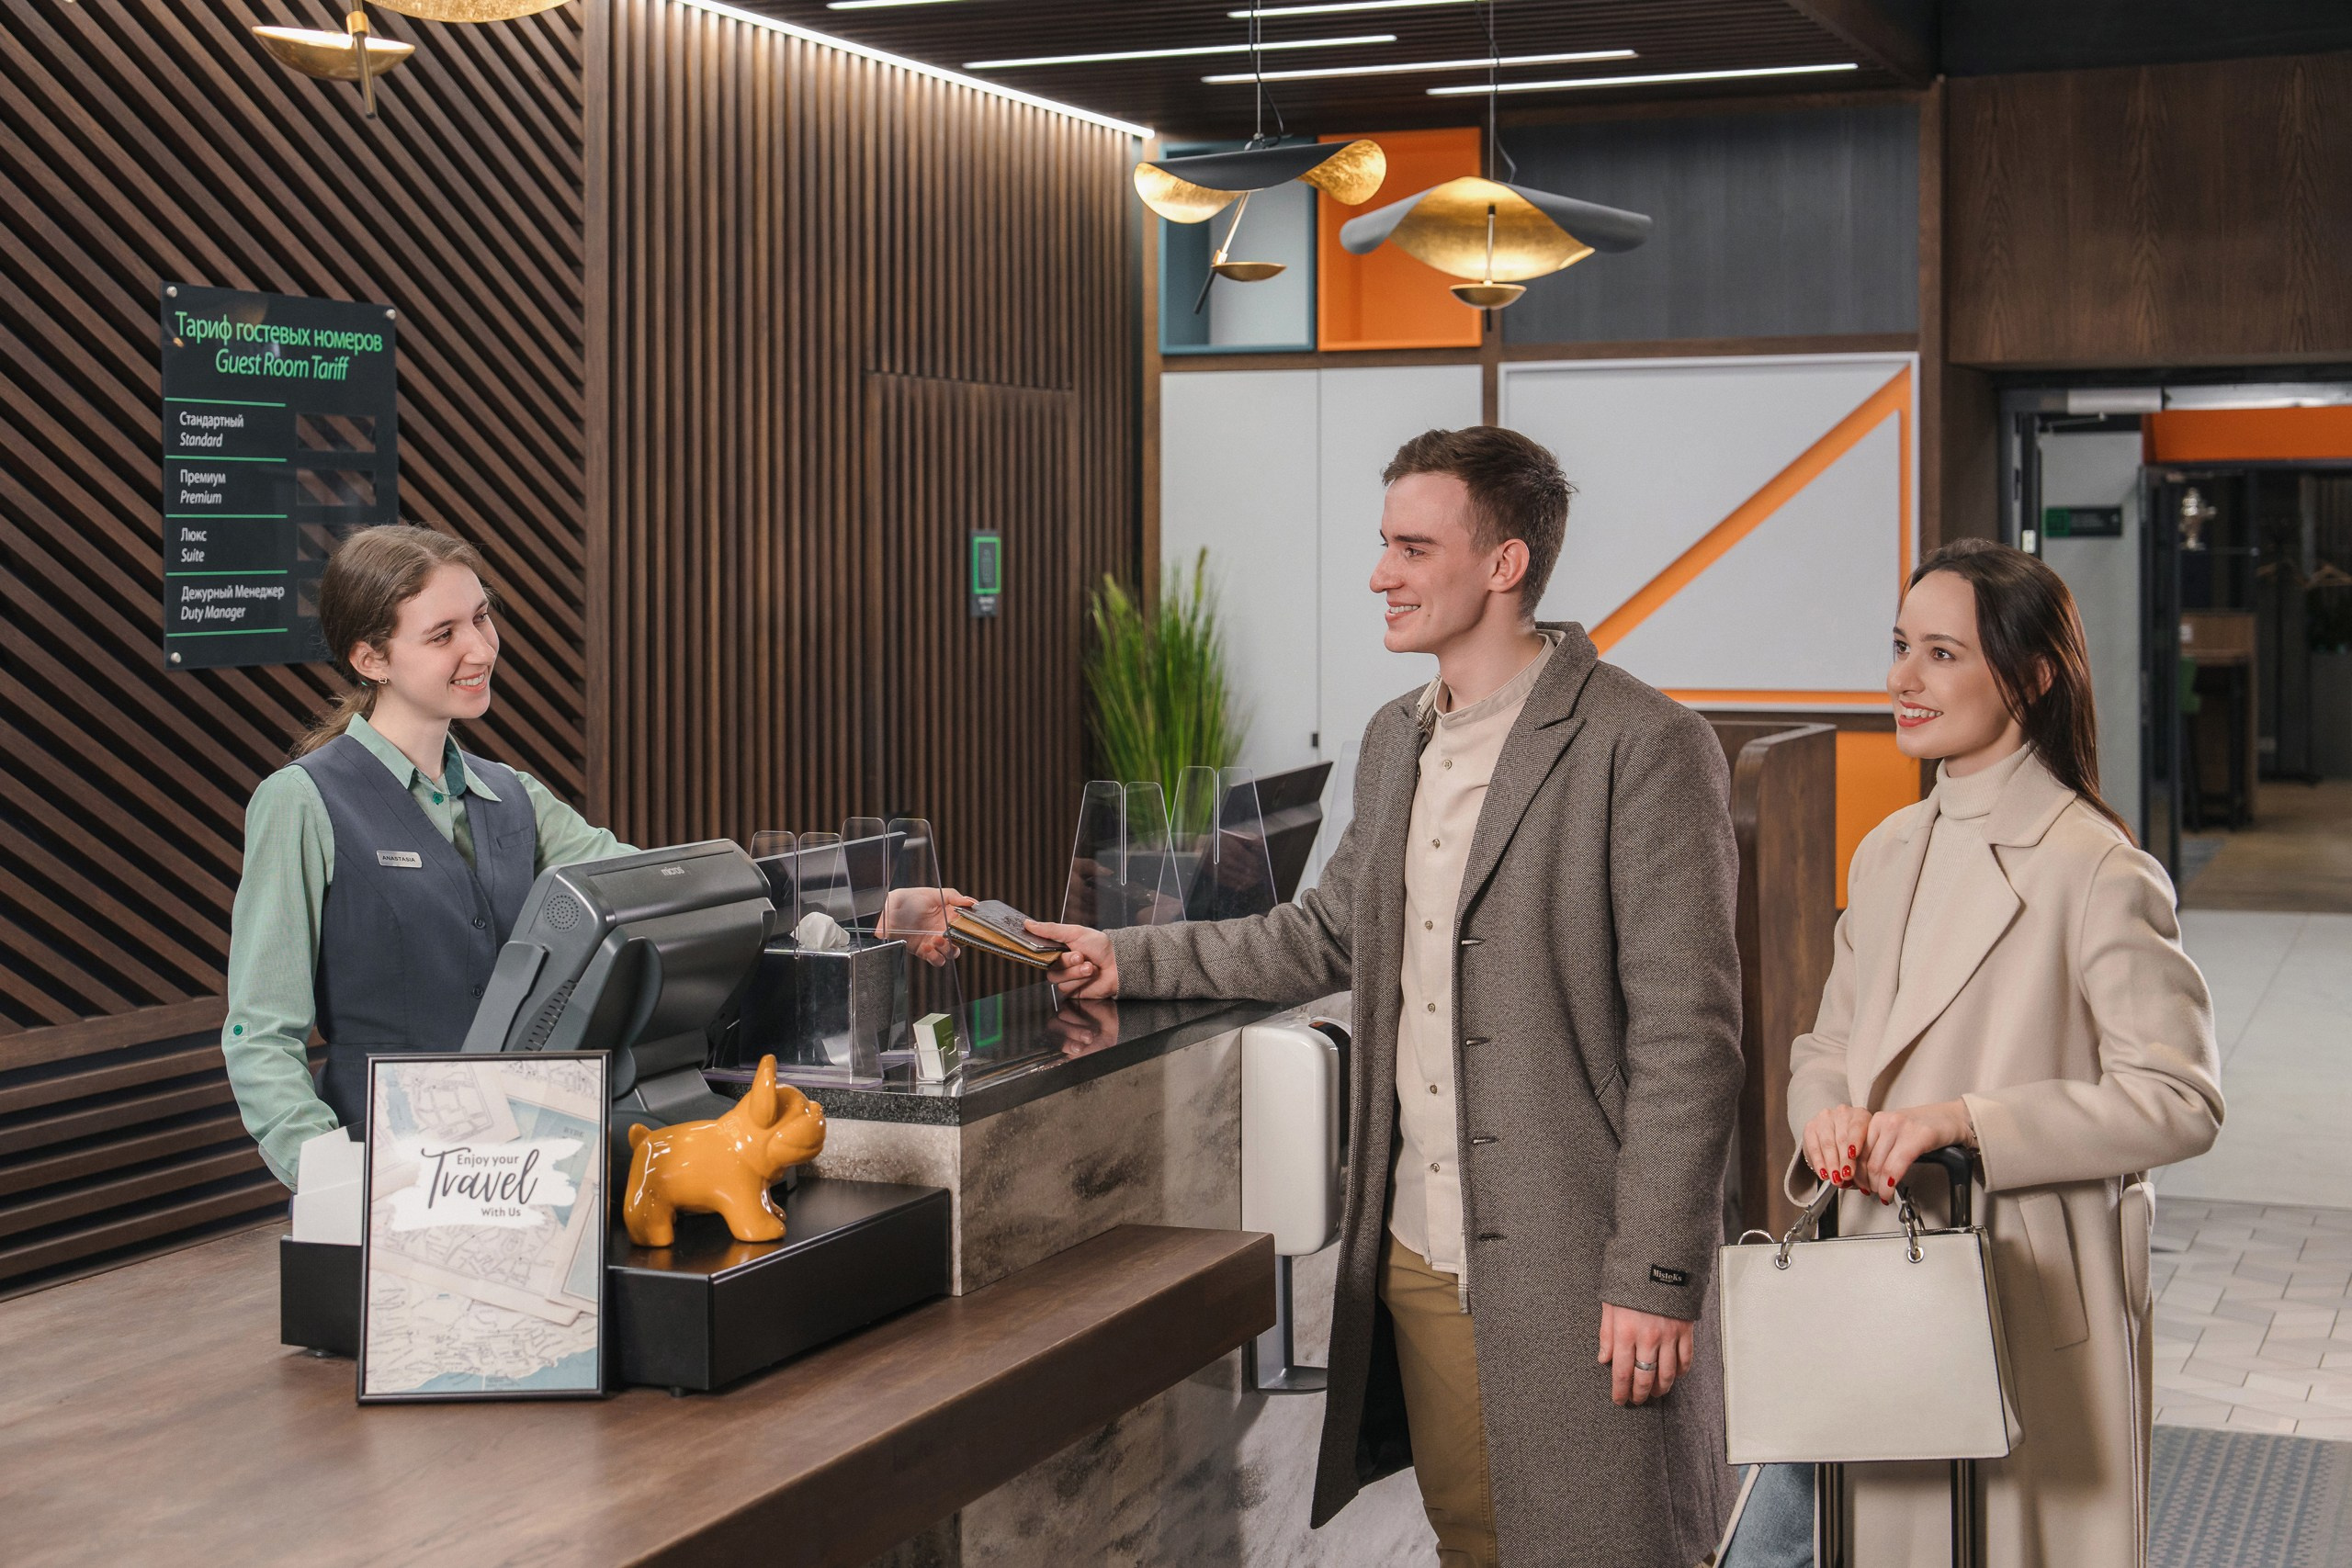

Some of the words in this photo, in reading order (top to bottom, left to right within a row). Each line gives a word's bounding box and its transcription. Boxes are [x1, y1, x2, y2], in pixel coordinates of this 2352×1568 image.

[175, 311, 232, 345] Тариф
[236, 322, 311, 347] гостевых
[314, 331, 382, 355] номеров
[215, 348, 262, 376] Guest
[264, 353, 309, 378] Room
[311, 355, 348, 380] Tariff
[179, 412, 243, 429] Стандартный
[179, 432, 222, 447] Standard
[180, 469, 226, 486] Премиум
[180, 490, 221, 504] Premium
[181, 528, 207, 543] Люкс
[181, 548, 205, 562] Suite
[181, 584, 233, 603] Дежурный
[235, 583, 285, 600] Менеджер
[181, 605, 203, 623] Duty
[205, 605, 246, 621] Manager
[661, 865, 685, 875] micros
[457, 1154, 489, 1167] Enjoy
[492, 1155, 520, 1168] your
[422, 1147, 538, 1209] Travel
[481, 1207, 505, 1217] With
[508, 1207, 521, 1217] Us
